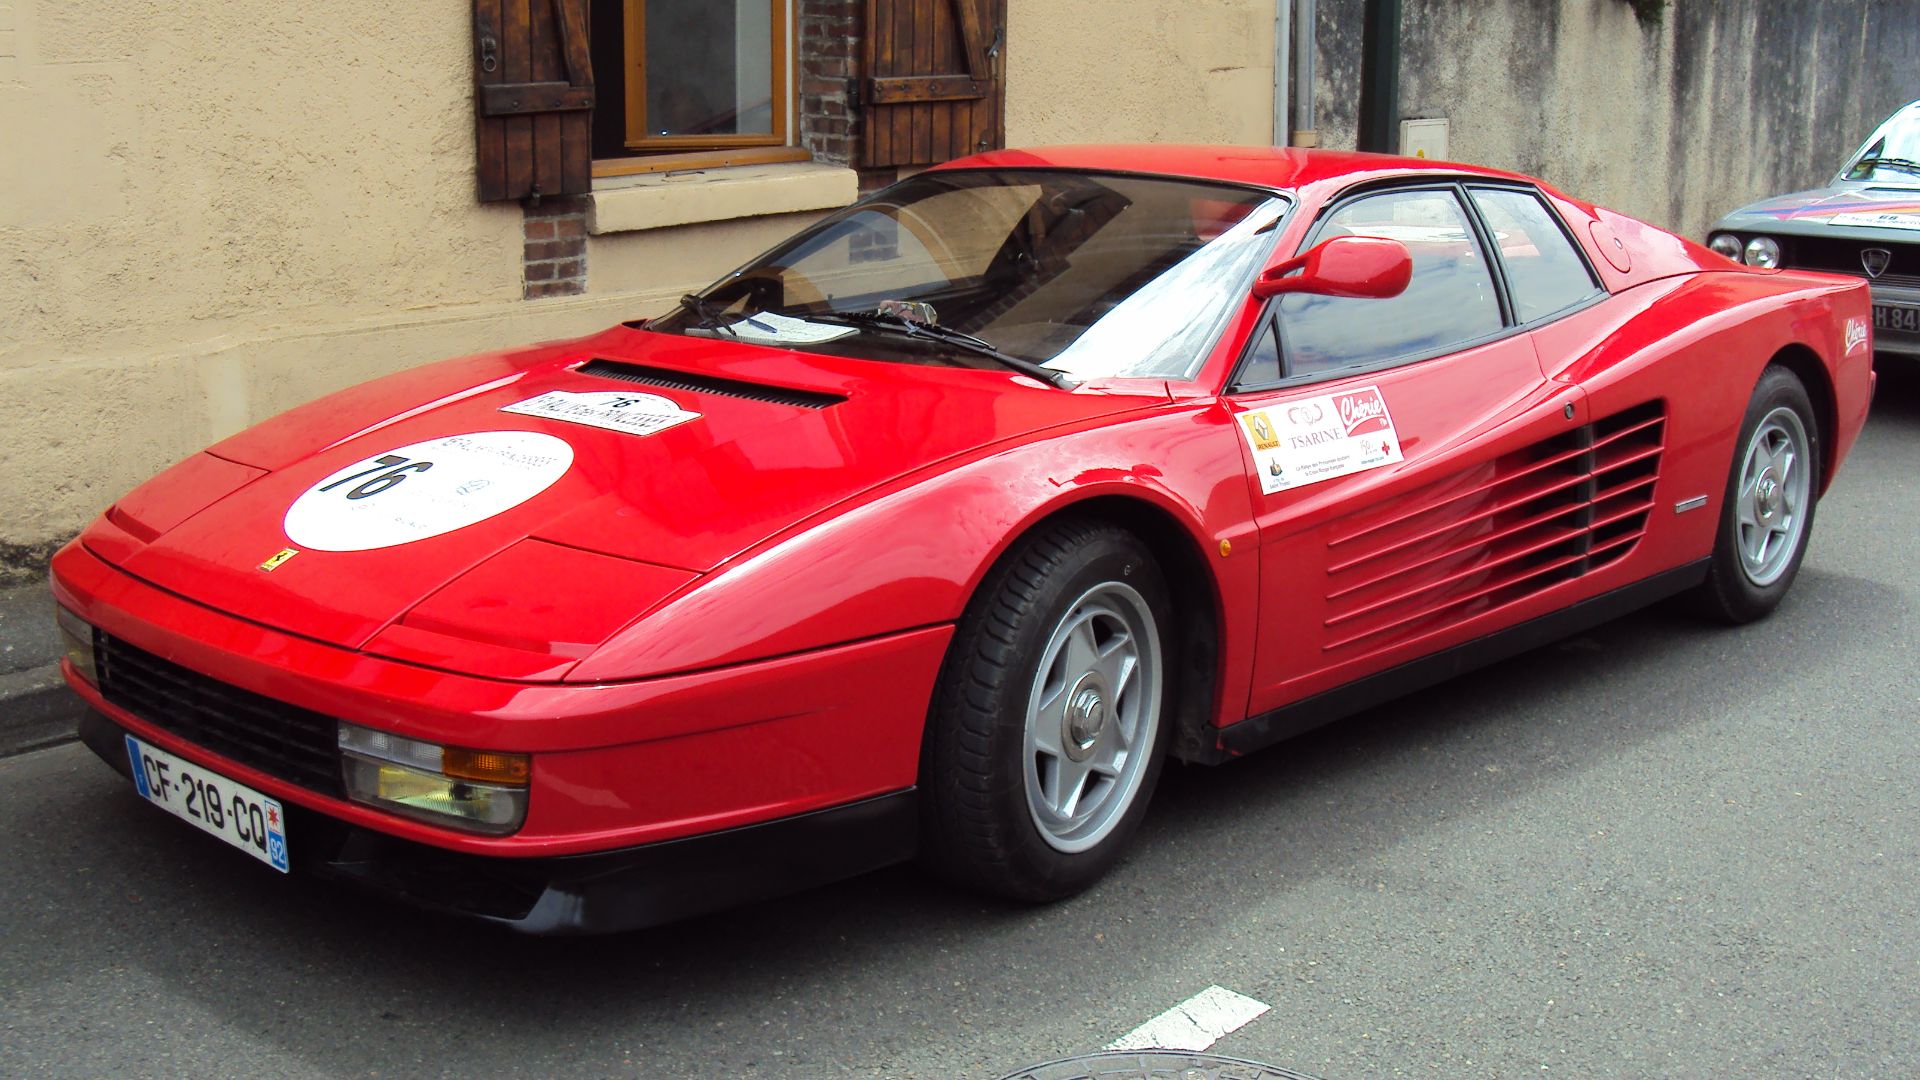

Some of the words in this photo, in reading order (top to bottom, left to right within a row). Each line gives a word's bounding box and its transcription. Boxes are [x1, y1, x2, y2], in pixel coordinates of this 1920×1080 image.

[599, 396, 640, 408] 76
[1340, 396, 1383, 426] Chérie
[1257, 440, 1280, 451] RENAULT
[1288, 427, 1343, 449] TSARINE
[318, 454, 434, 500] 76
[143, 754, 268, 854] CF-219-CQ
[270, 838, 286, 864] 92
